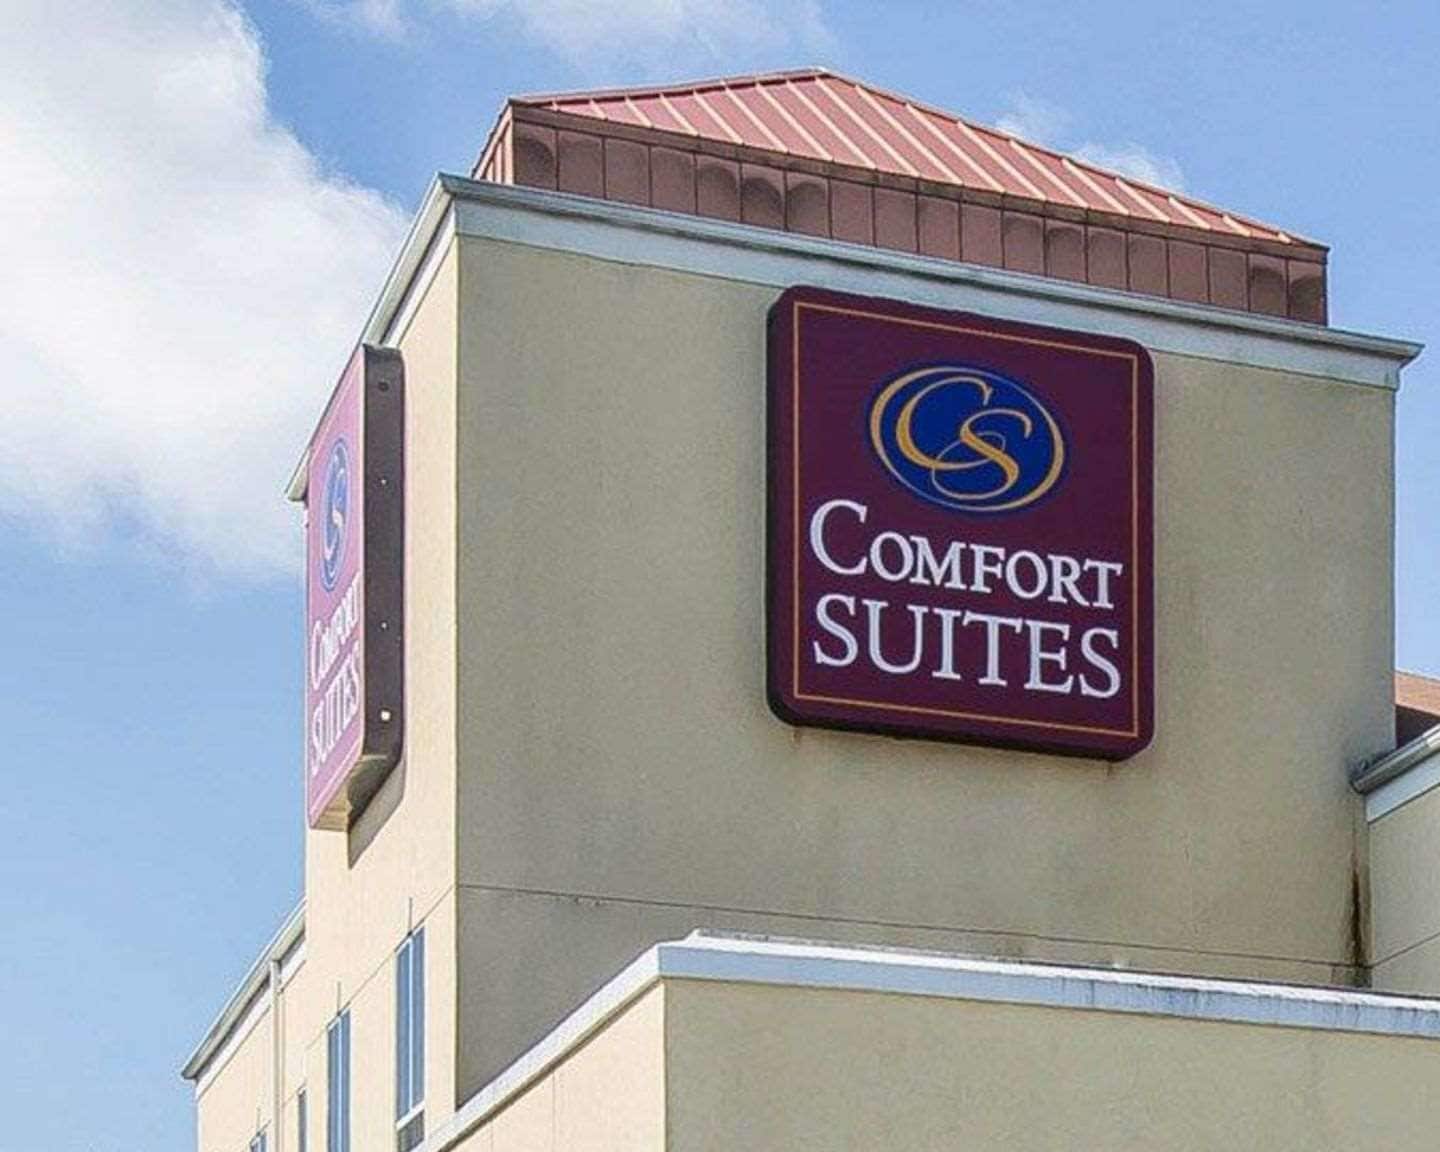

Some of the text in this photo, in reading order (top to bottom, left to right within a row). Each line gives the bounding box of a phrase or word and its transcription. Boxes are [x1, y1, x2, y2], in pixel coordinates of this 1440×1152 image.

[895, 374, 1033, 501] CS
[809, 499, 1123, 609] COMFORT
[813, 593, 1121, 699] SUITES
